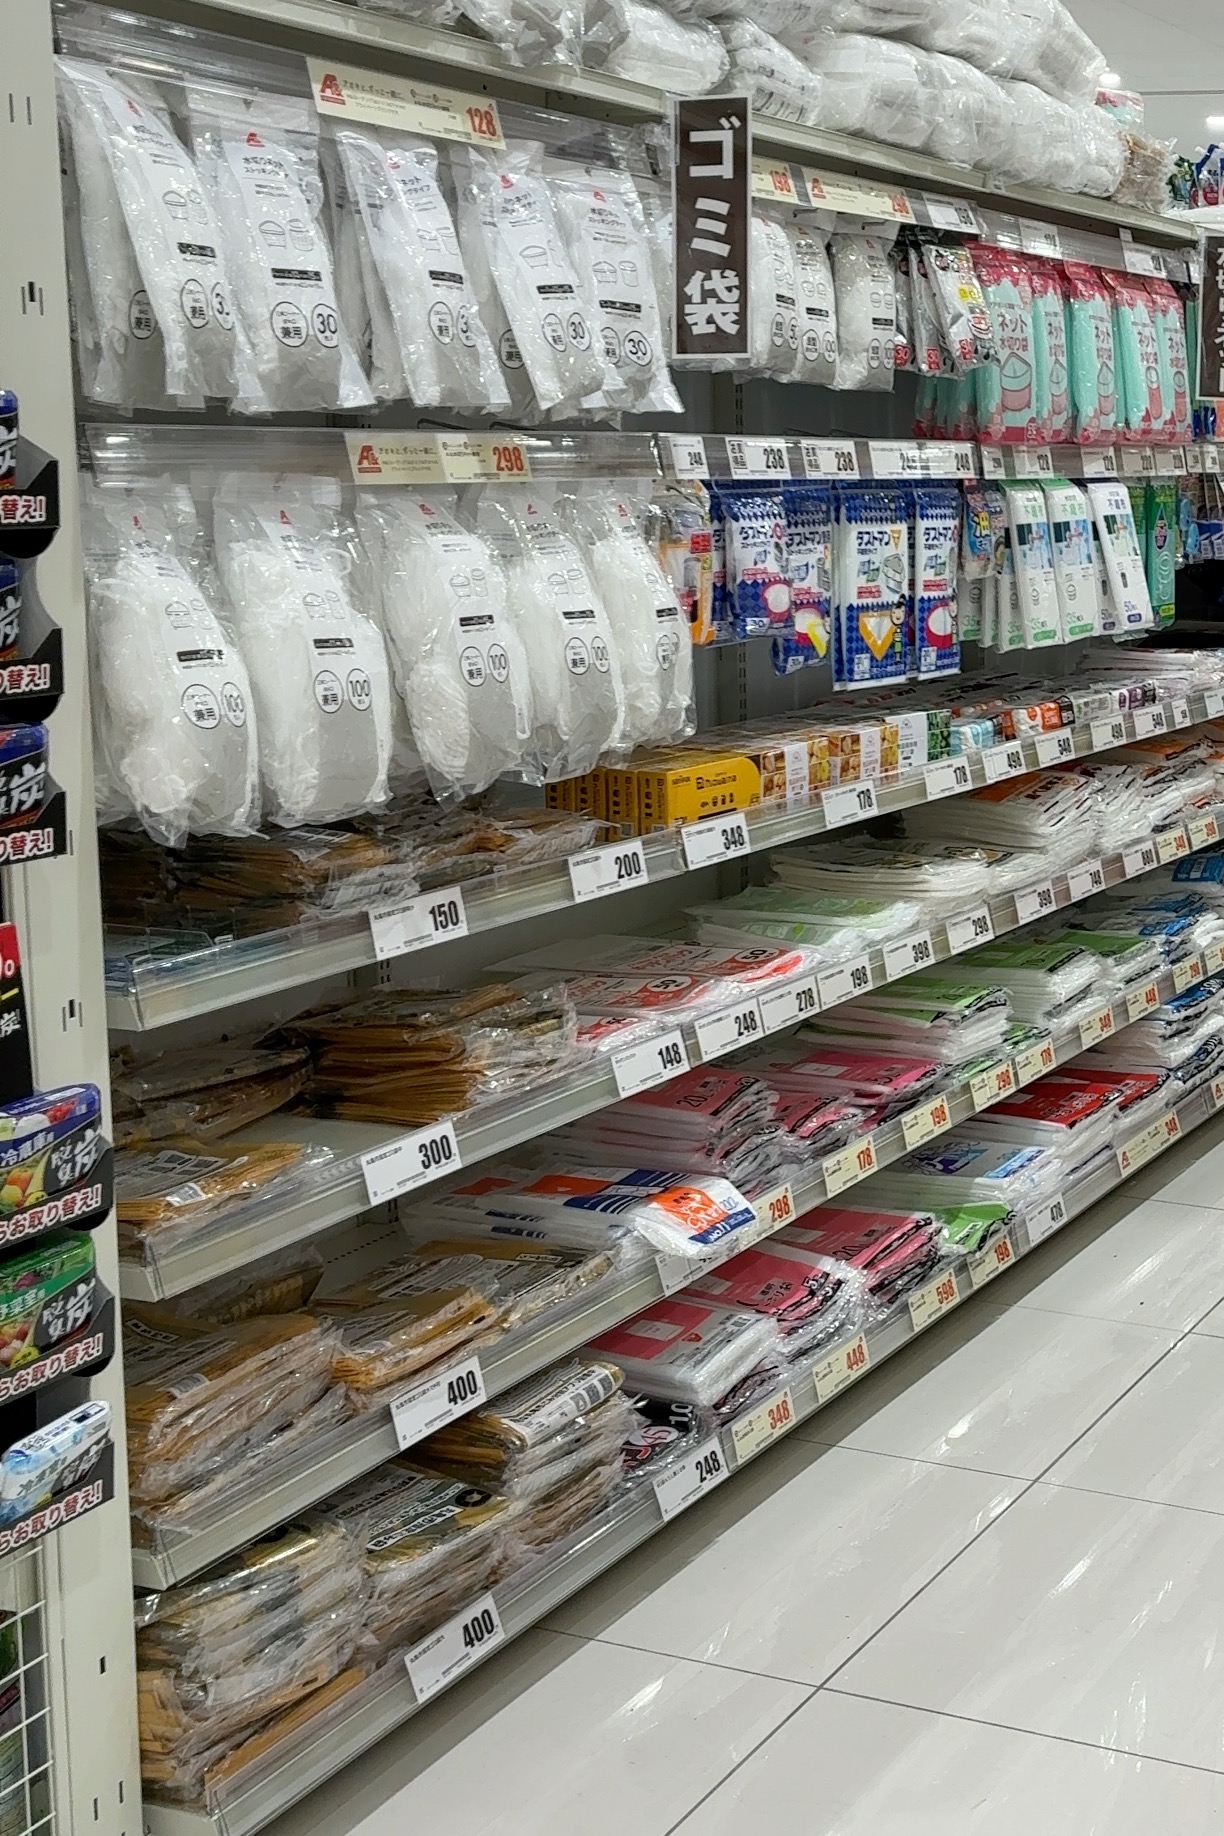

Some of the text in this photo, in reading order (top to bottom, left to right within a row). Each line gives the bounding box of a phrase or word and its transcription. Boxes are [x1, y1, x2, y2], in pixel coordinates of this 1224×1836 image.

[466, 106, 497, 137] 128
[683, 114, 743, 337] ゴミ袋
[317, 313, 338, 334] 30
[569, 321, 586, 339] 30
[999, 313, 1028, 332] ネット
[627, 338, 648, 358] 30
[492, 446, 525, 472] 298
[763, 448, 785, 470] 238
[834, 450, 855, 472] 238
[856, 530, 891, 547] ダストマン
[350, 679, 371, 698] 100
[1006, 749, 1023, 771] 498
[952, 766, 969, 786] 178
[857, 788, 875, 811] 178
[721, 825, 745, 851] 348
[615, 851, 642, 880] 200
[428, 900, 461, 931] 150
[972, 914, 990, 937] 298
[912, 940, 931, 962] 398
[850, 965, 869, 988] 198
[795, 988, 817, 1013] 278
[734, 1009, 758, 1037] 248
[657, 1041, 683, 1070] 148
[994, 1069, 1012, 1091] 298
[929, 1103, 948, 1127] 198
[418, 1134, 453, 1170] 300
[856, 1145, 874, 1172] 178
[768, 1195, 791, 1223] 298
[935, 1275, 955, 1304] 598
[846, 1344, 866, 1371] 448
[447, 1369, 479, 1406] 400
[768, 1400, 791, 1431] 348
[695, 1449, 721, 1483] 248
[462, 1608, 497, 1649] 400
